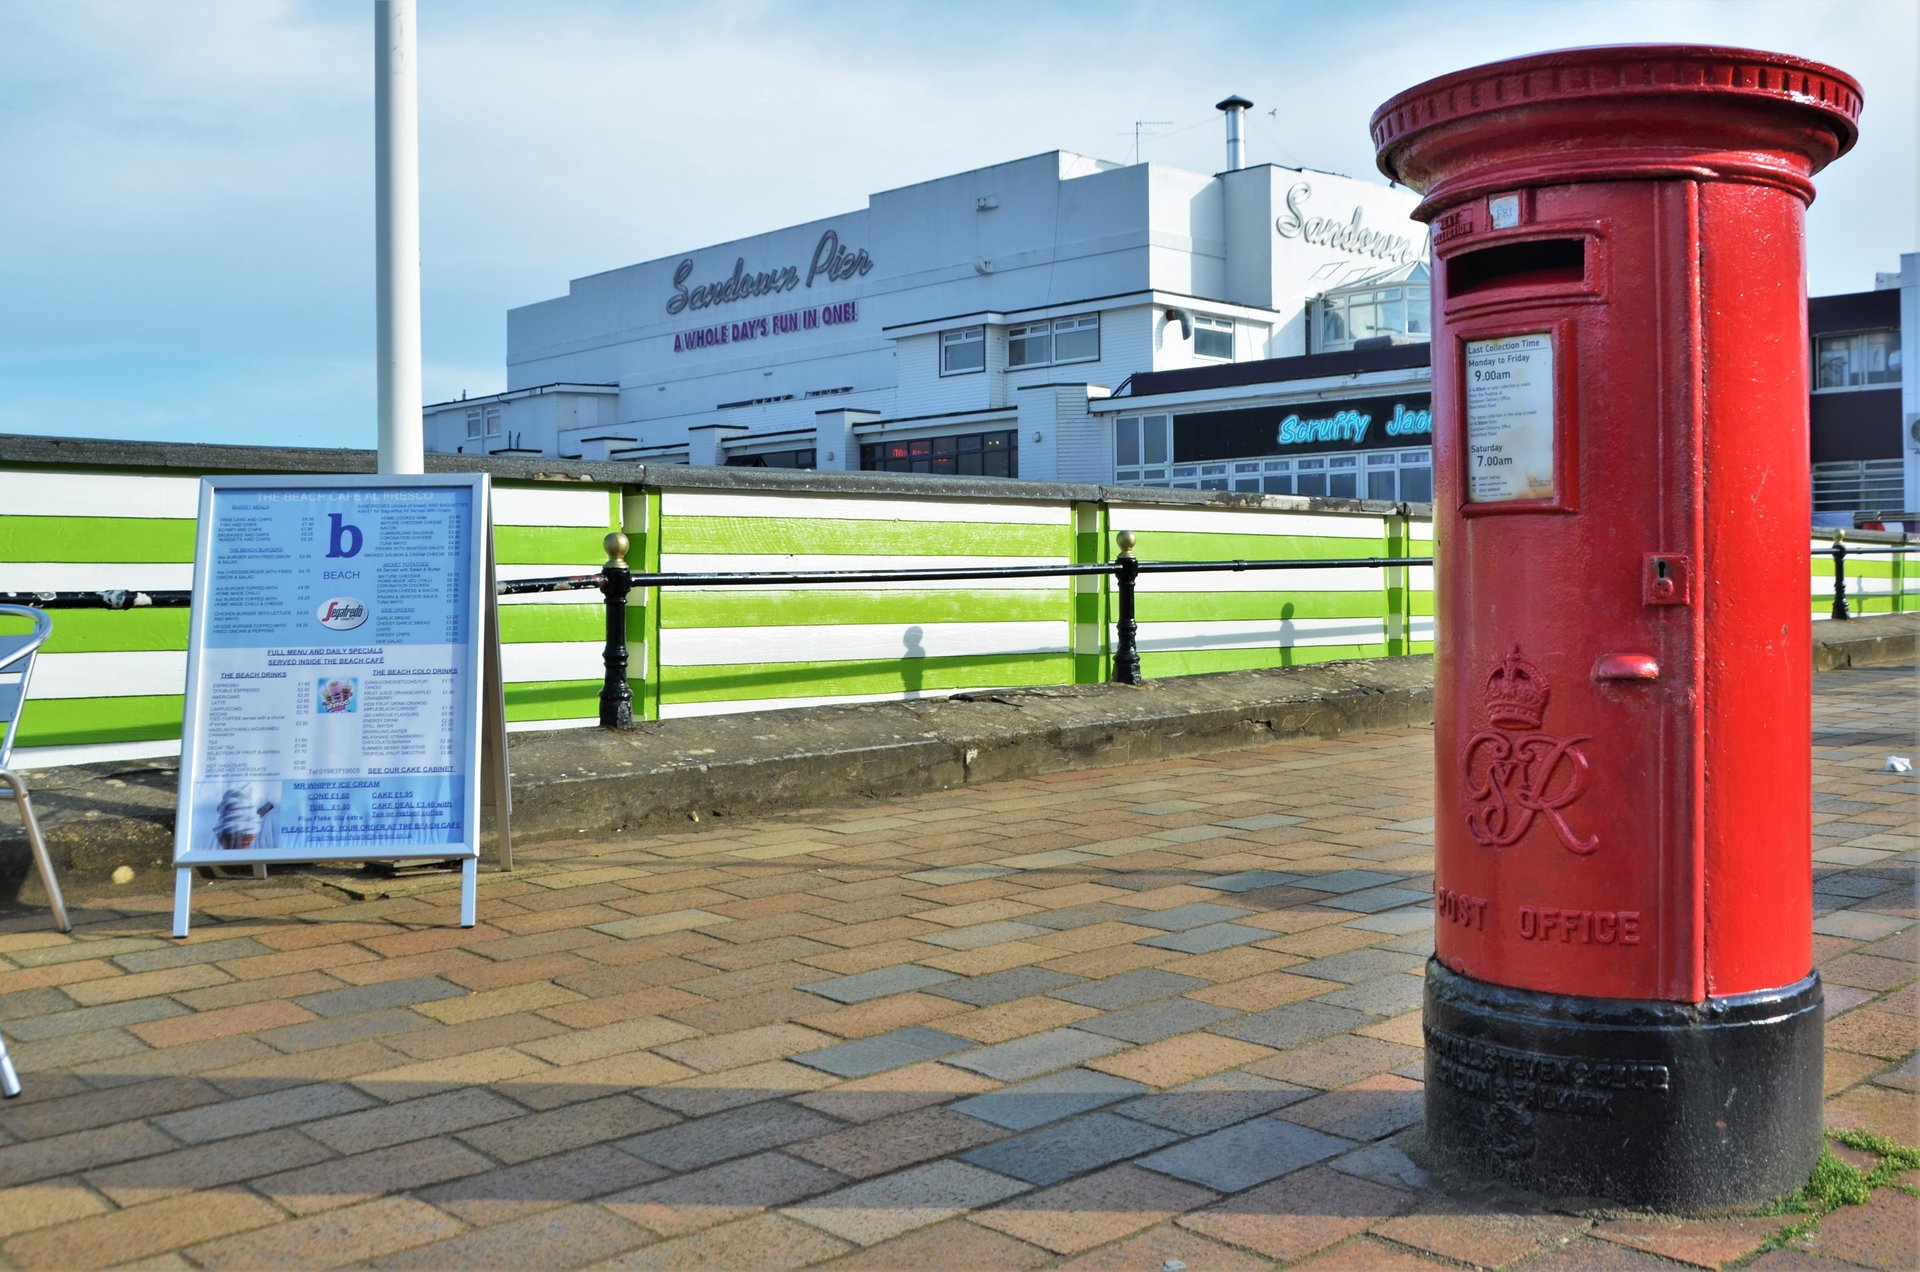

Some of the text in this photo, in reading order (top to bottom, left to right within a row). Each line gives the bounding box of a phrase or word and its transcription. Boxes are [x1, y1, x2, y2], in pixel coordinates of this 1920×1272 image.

[1496, 208, 1512, 219] FRI
[1276, 182, 1412, 263] Sandown
[666, 229, 873, 314] Sandown Pier
[674, 335, 684, 352] A
[685, 325, 728, 350] WHOLE
[773, 312, 799, 335] FUN
[803, 308, 819, 330] IN
[822, 302, 857, 326] ONE!
[1485, 342, 1519, 352] Collection
[1521, 340, 1540, 348] Time
[1469, 358, 1495, 367] Monday
[1508, 354, 1530, 362] Friday
[1475, 370, 1510, 382] 9.00am
[1278, 410, 1371, 444] Scruffy
[1471, 444, 1503, 453] Saturday
[1477, 455, 1512, 467] 7.00am
[257, 493, 280, 501] THE
[285, 492, 324, 501] BEACH
[384, 490, 434, 499] FRESCO
[326, 513, 363, 558] b
[323, 571, 360, 580] BEACH
[321, 602, 363, 622] Segafredo
[309, 648, 323, 656] AND
[349, 647, 383, 655] SPECIALS
[268, 658, 297, 666] SERVED
[323, 657, 336, 665] THE
[338, 657, 362, 665] BEACH
[1439, 886, 1640, 945] POST OFFICE
